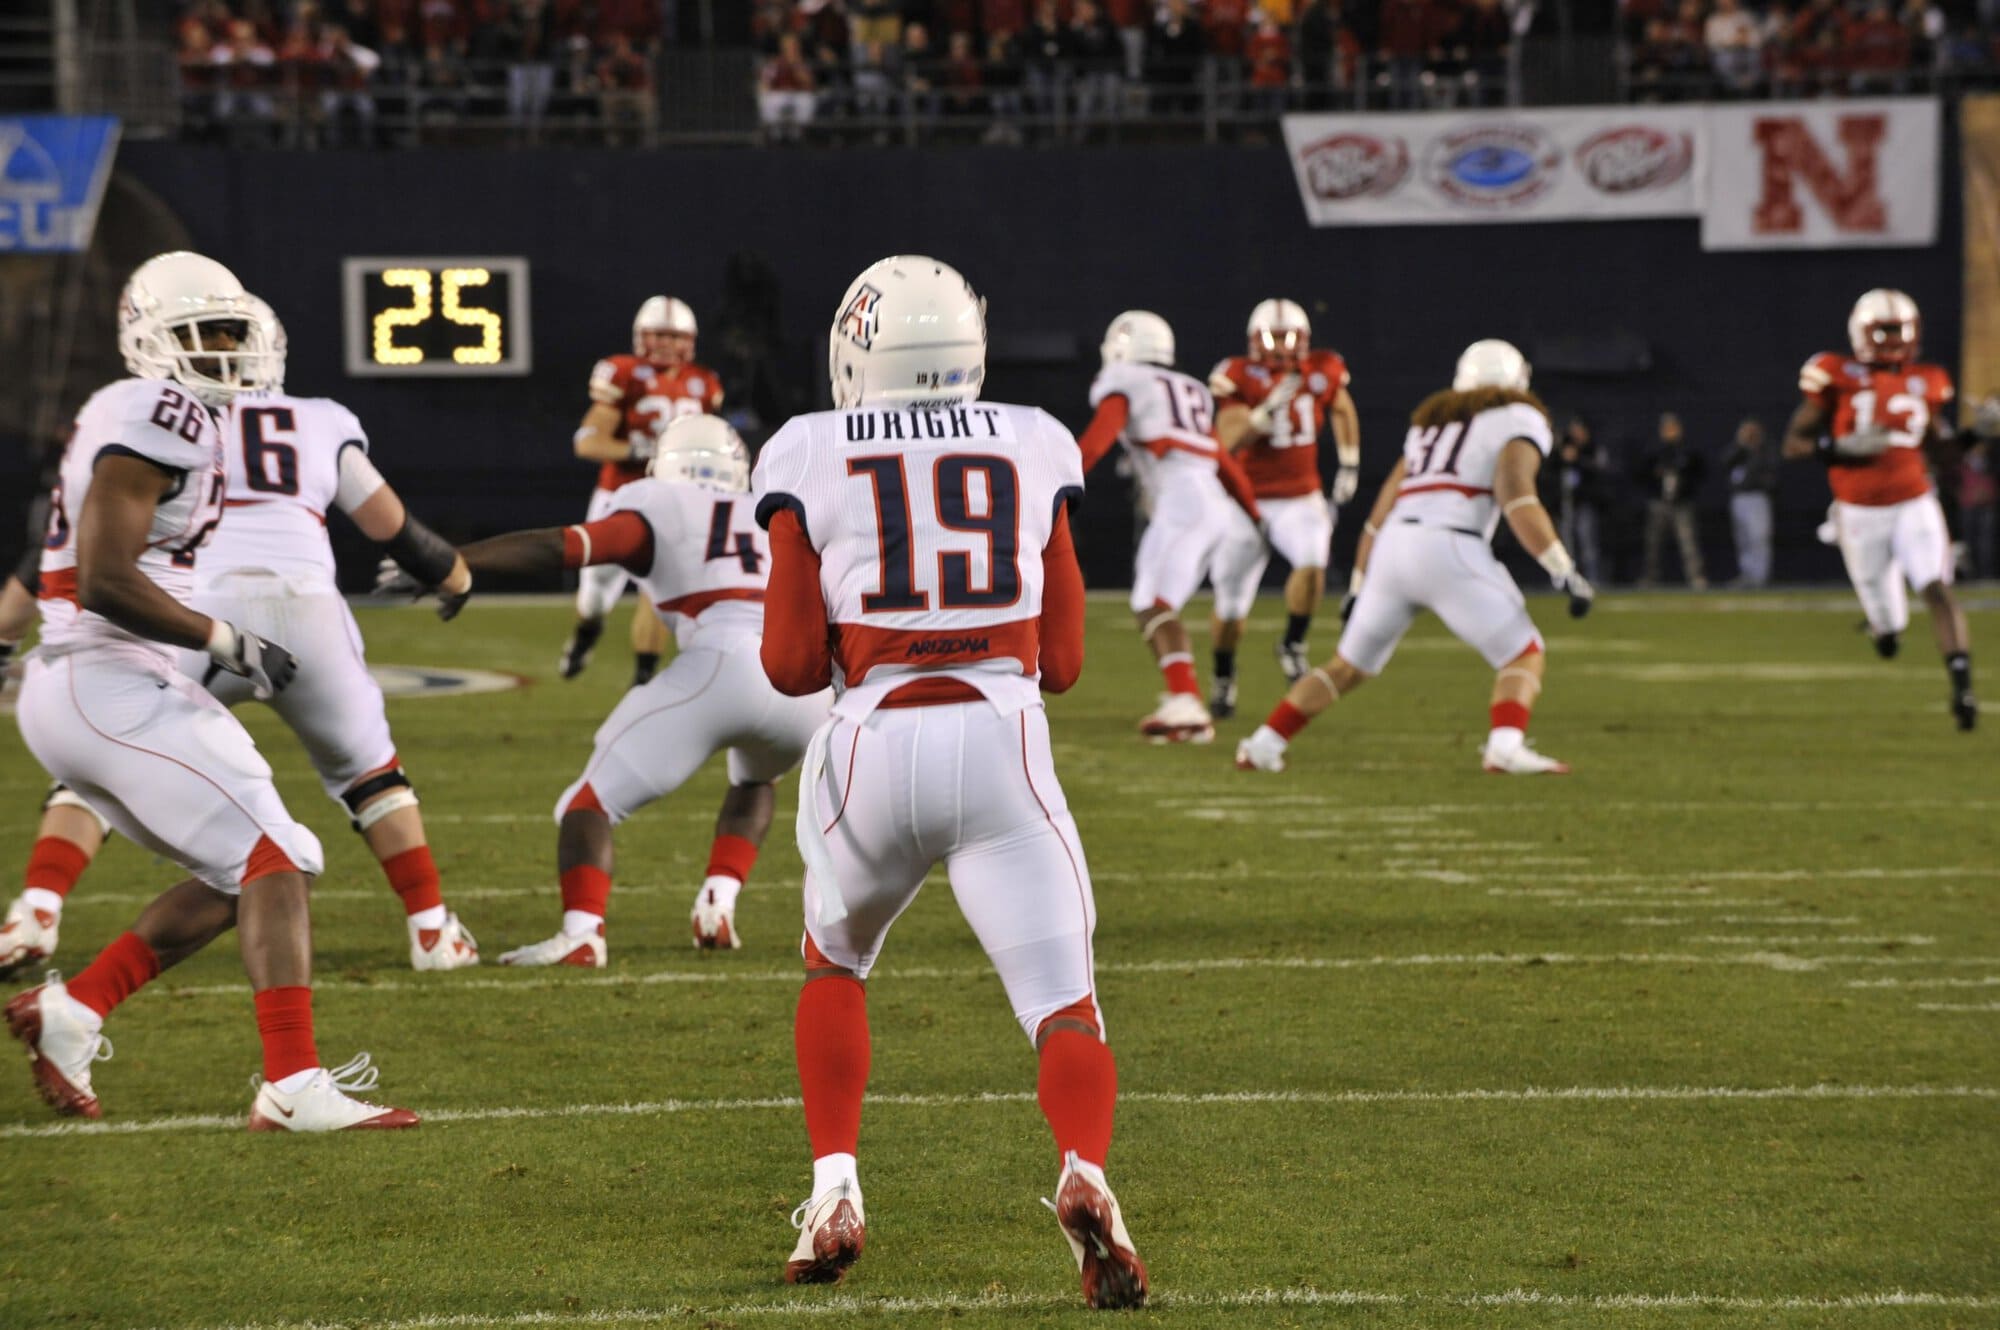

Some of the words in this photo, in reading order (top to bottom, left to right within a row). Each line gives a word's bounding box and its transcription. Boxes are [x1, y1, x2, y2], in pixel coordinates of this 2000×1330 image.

[1752, 113, 1887, 234] N
[373, 268, 501, 364] 25
[150, 387, 204, 444] 26
[238, 406, 299, 497] 6
[846, 408, 1000, 441] WRIGHT
[1851, 390, 1929, 448] 13
[704, 501, 764, 574] 4
[846, 452, 1022, 615] 19
[906, 637, 989, 657] ARIZONA
